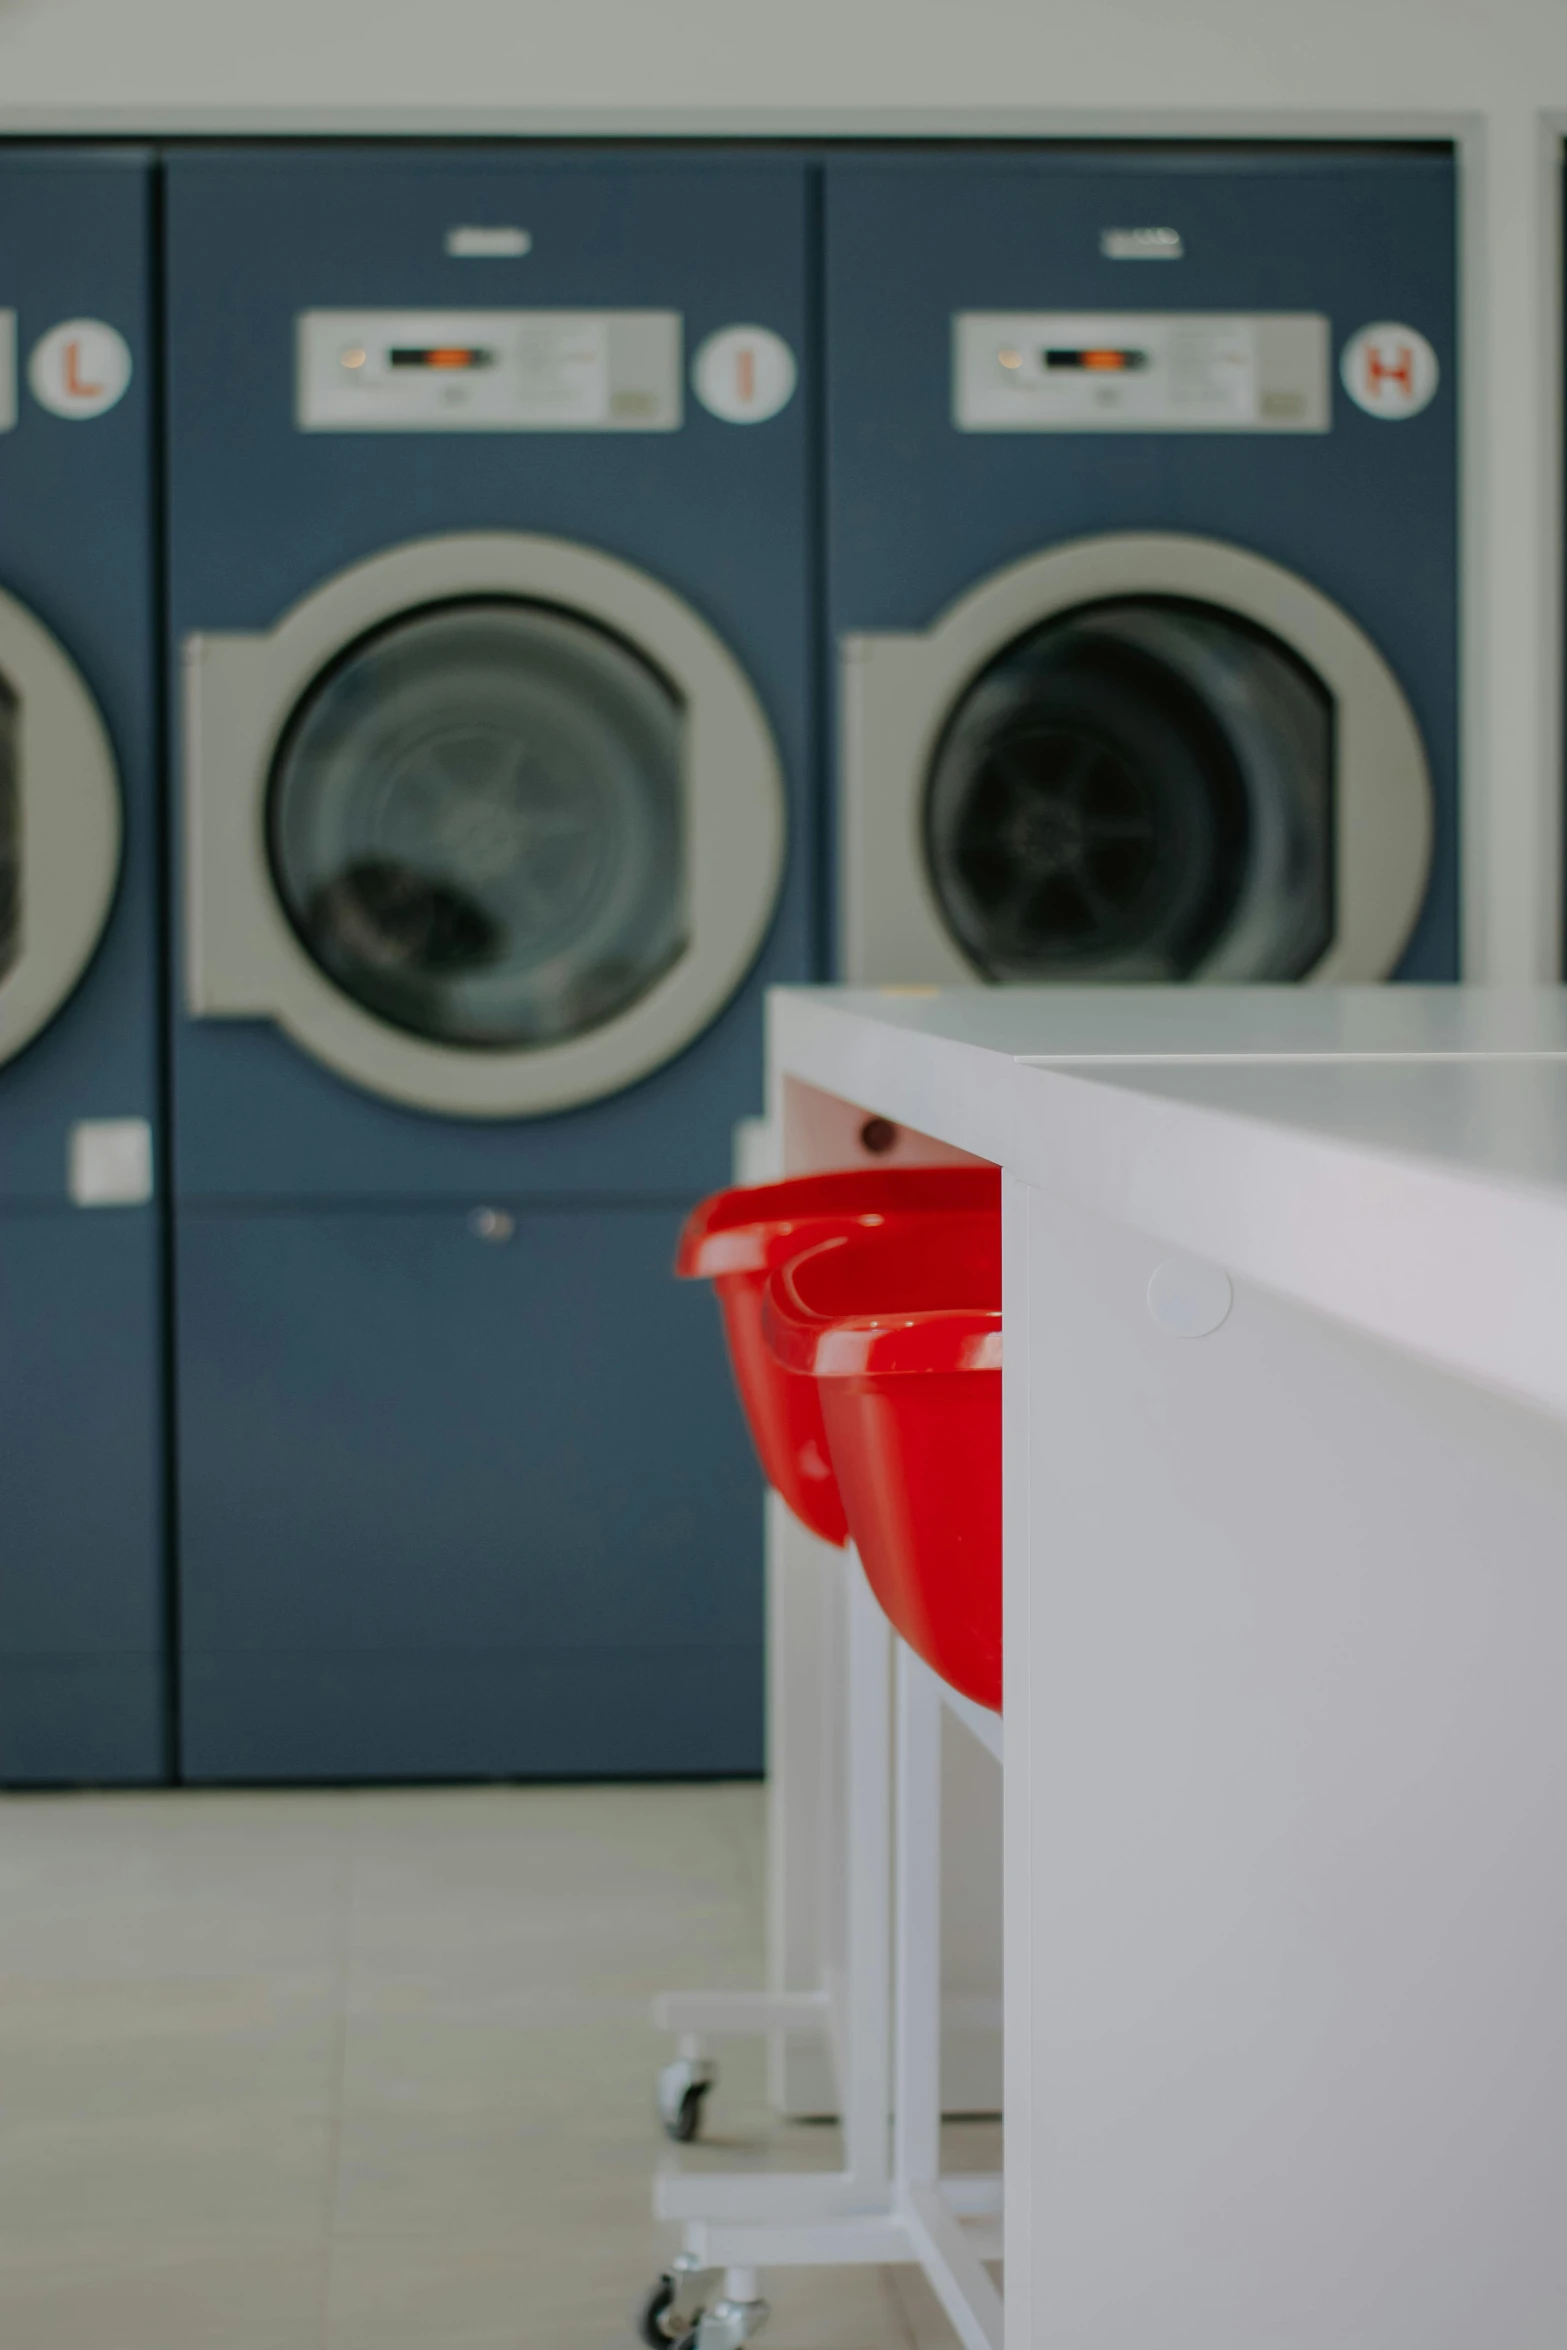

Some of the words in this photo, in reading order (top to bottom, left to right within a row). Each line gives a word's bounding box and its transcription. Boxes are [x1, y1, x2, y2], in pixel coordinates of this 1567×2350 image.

[63, 340, 103, 398] L
[736, 349, 755, 402] I
[1364, 344, 1414, 400] H
